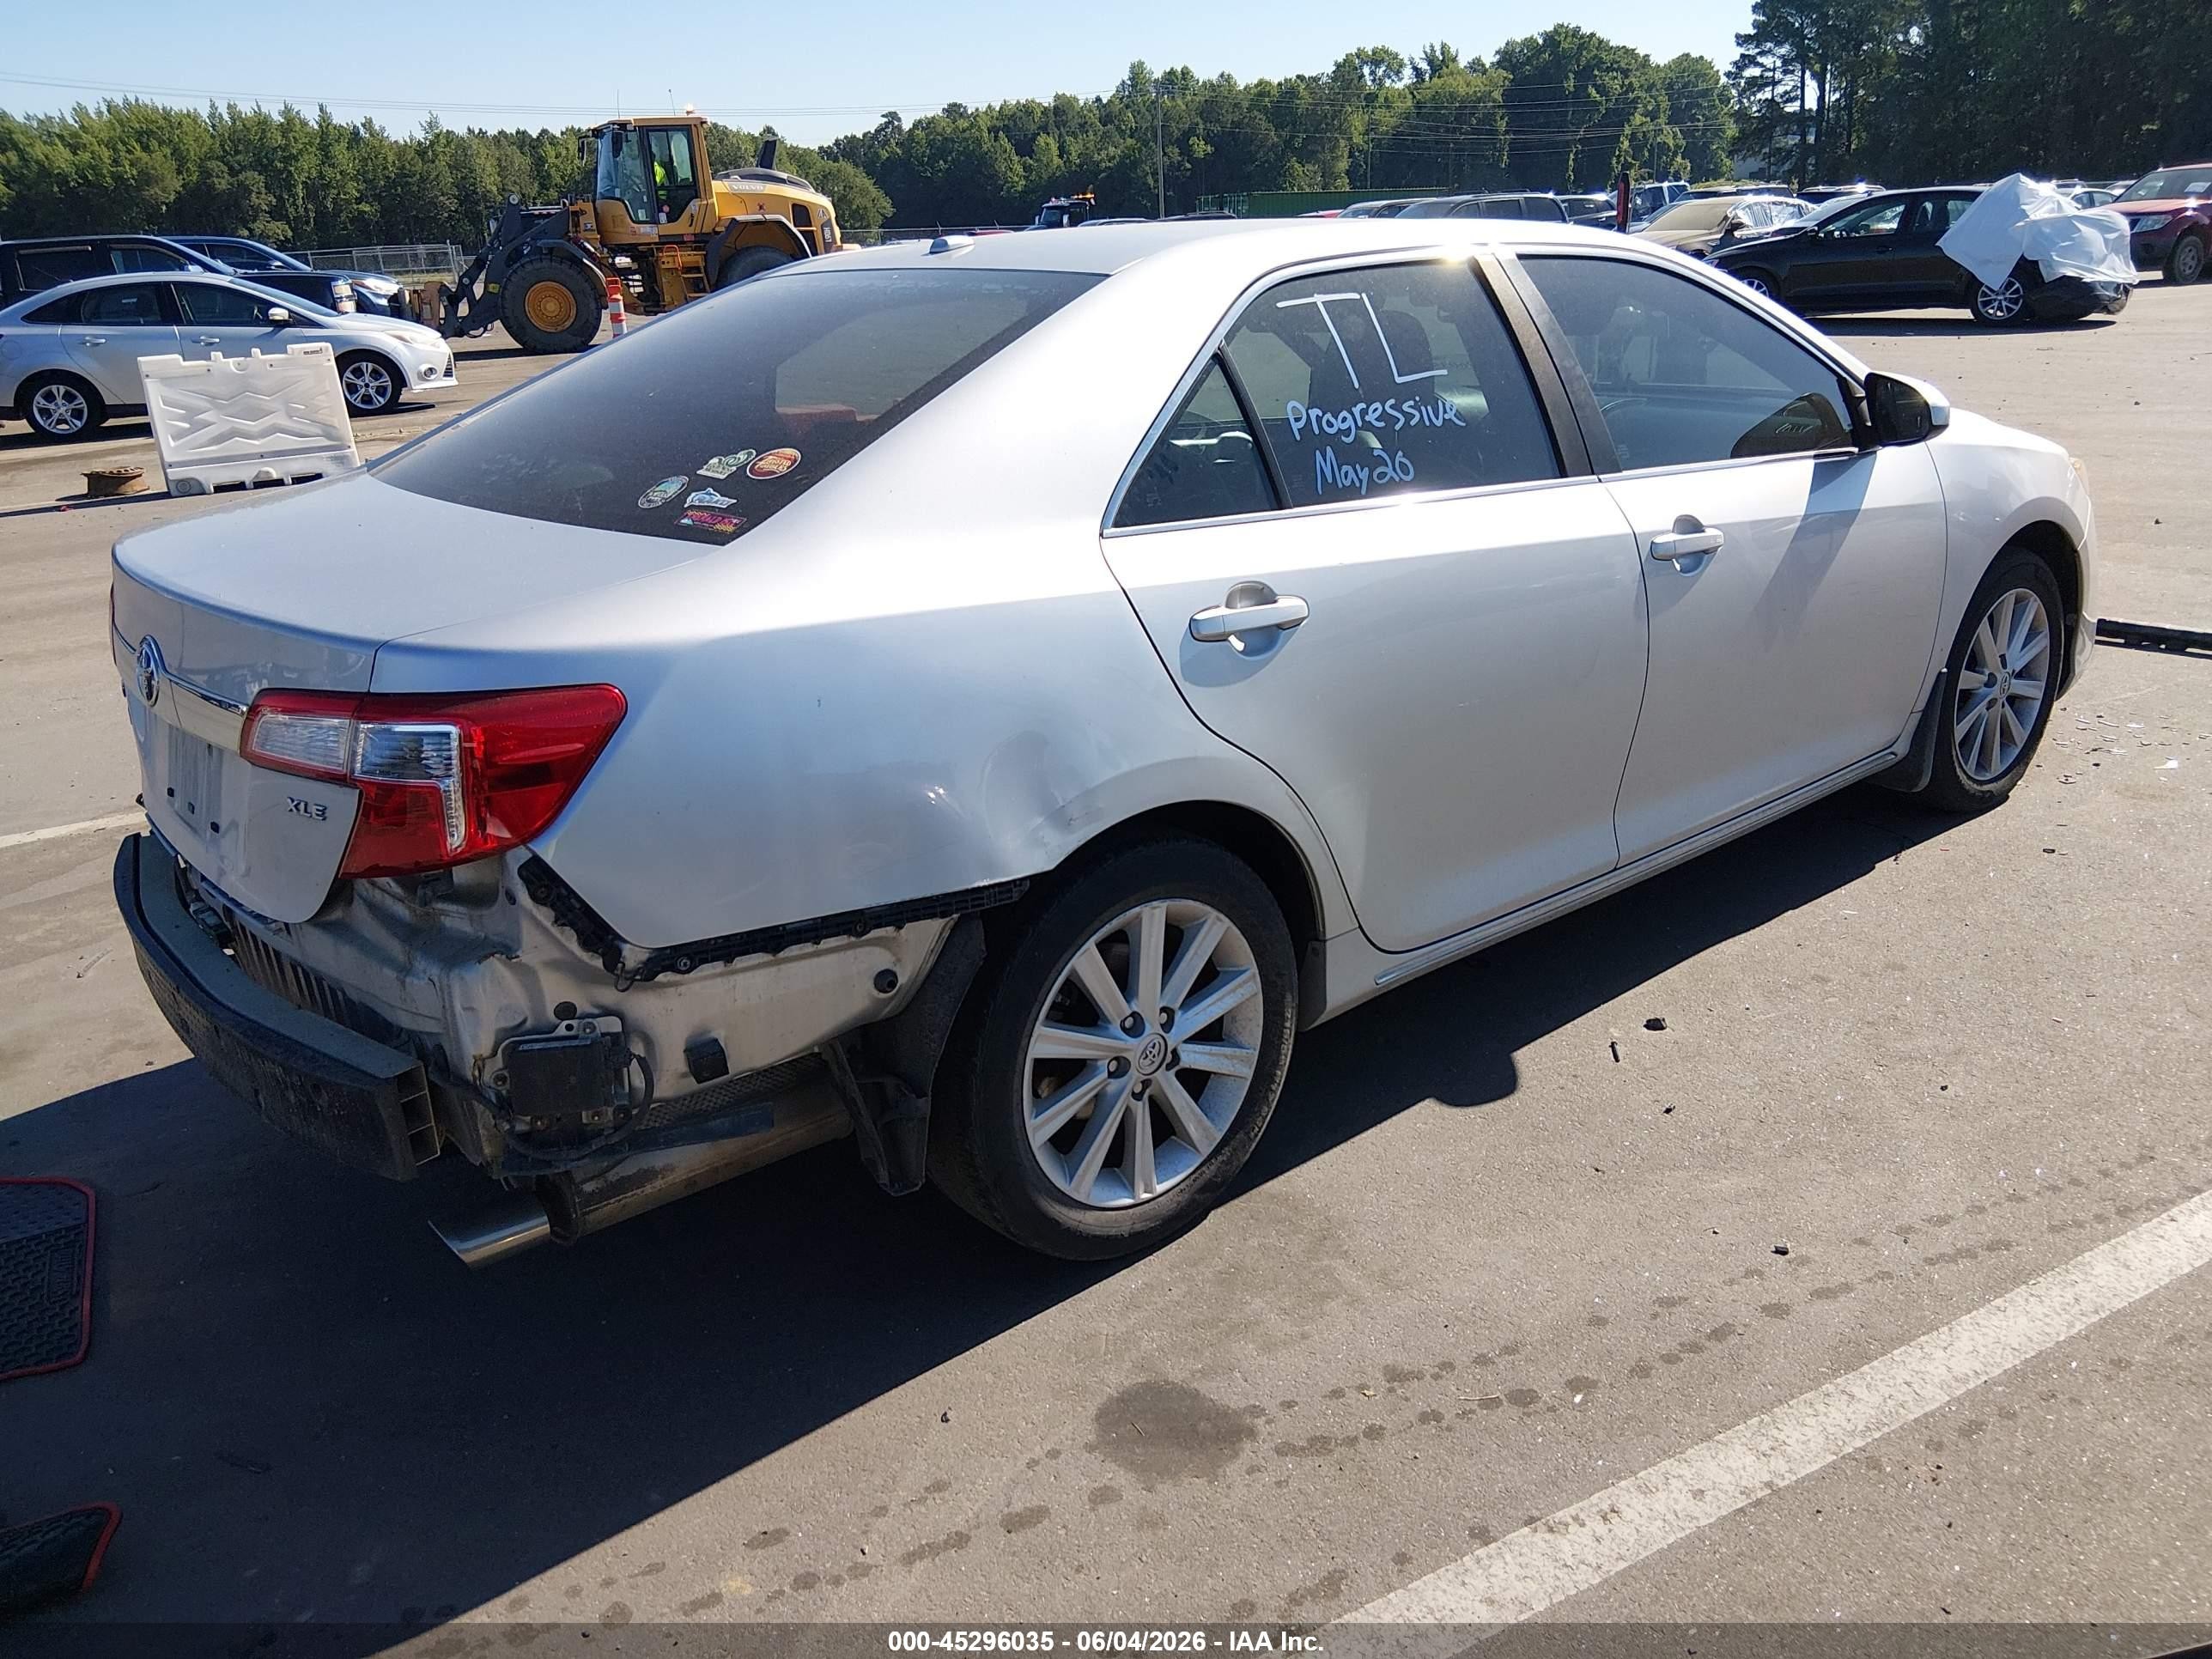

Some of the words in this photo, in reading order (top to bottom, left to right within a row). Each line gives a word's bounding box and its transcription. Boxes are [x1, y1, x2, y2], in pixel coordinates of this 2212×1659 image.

[1276, 292, 1449, 389] TL
[1286, 396, 1467, 444] Progressive
[1315, 446, 1369, 495] May
[287, 796, 328, 821] XLE
